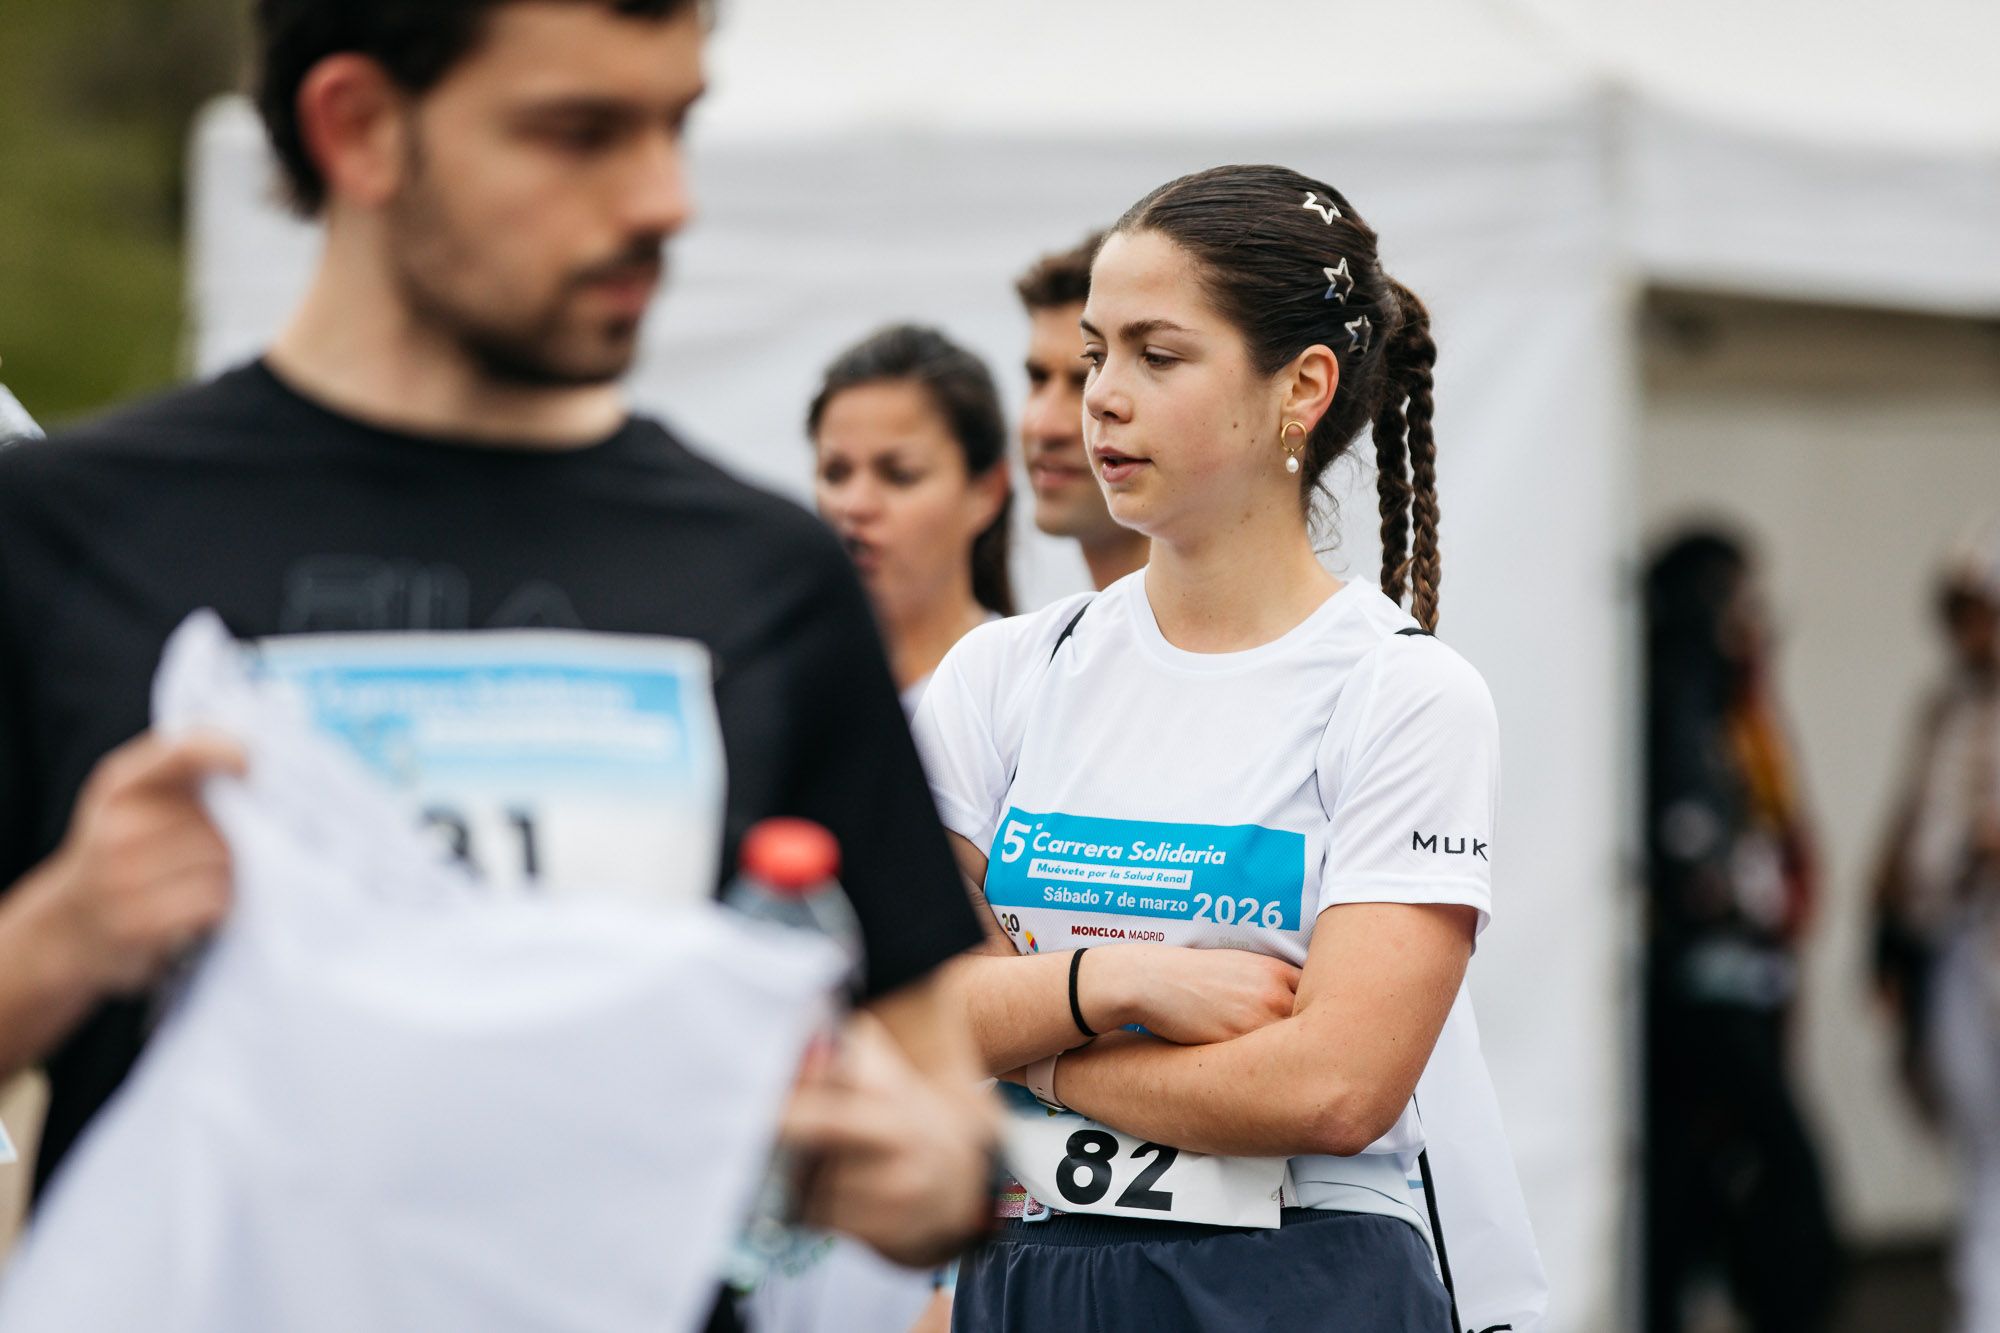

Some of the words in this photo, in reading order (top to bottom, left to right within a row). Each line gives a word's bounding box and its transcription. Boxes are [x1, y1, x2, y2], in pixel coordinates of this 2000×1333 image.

[1032, 831, 1123, 860] Carrera
[1127, 840, 1226, 865] Solidaria
[1036, 862, 1085, 877] Muévete
[1087, 869, 1107, 879] por
[1109, 868, 1120, 879] la
[1123, 869, 1154, 882] Salud
[1156, 872, 1187, 884] Renal
[1043, 885, 1100, 905] Sábado
[1104, 890, 1114, 906] 7
[1116, 891, 1136, 908] de
[1139, 896, 1189, 913] marzo
[1192, 892, 1284, 930] 2026
[1071, 925, 1126, 939] MONCLOA
[1128, 929, 1165, 942] MADRID
[1056, 1129, 1179, 1212] 82
